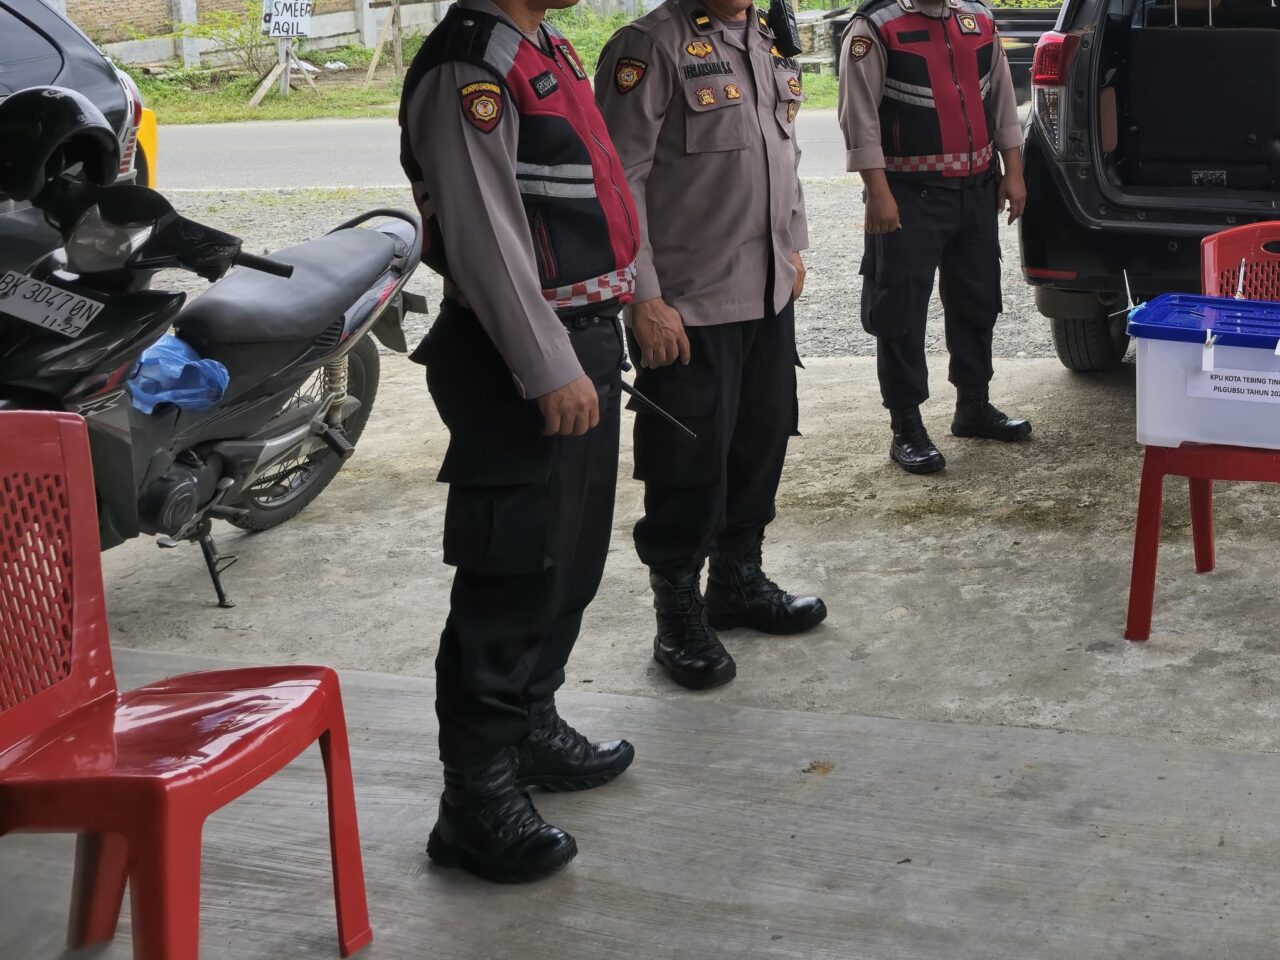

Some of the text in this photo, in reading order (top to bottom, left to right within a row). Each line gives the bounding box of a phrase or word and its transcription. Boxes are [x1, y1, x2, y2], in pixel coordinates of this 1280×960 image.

[274, 1, 312, 18] SMEER
[272, 21, 305, 35] AQIL
[0, 273, 28, 296] BK
[23, 283, 75, 311] 3047
[1210, 373, 1223, 381] KPU
[1224, 375, 1242, 383] KOTA
[1242, 376, 1267, 385] TEBING
[1213, 385, 1245, 395] PILGUBSU
[1246, 387, 1269, 397] TAHUN
